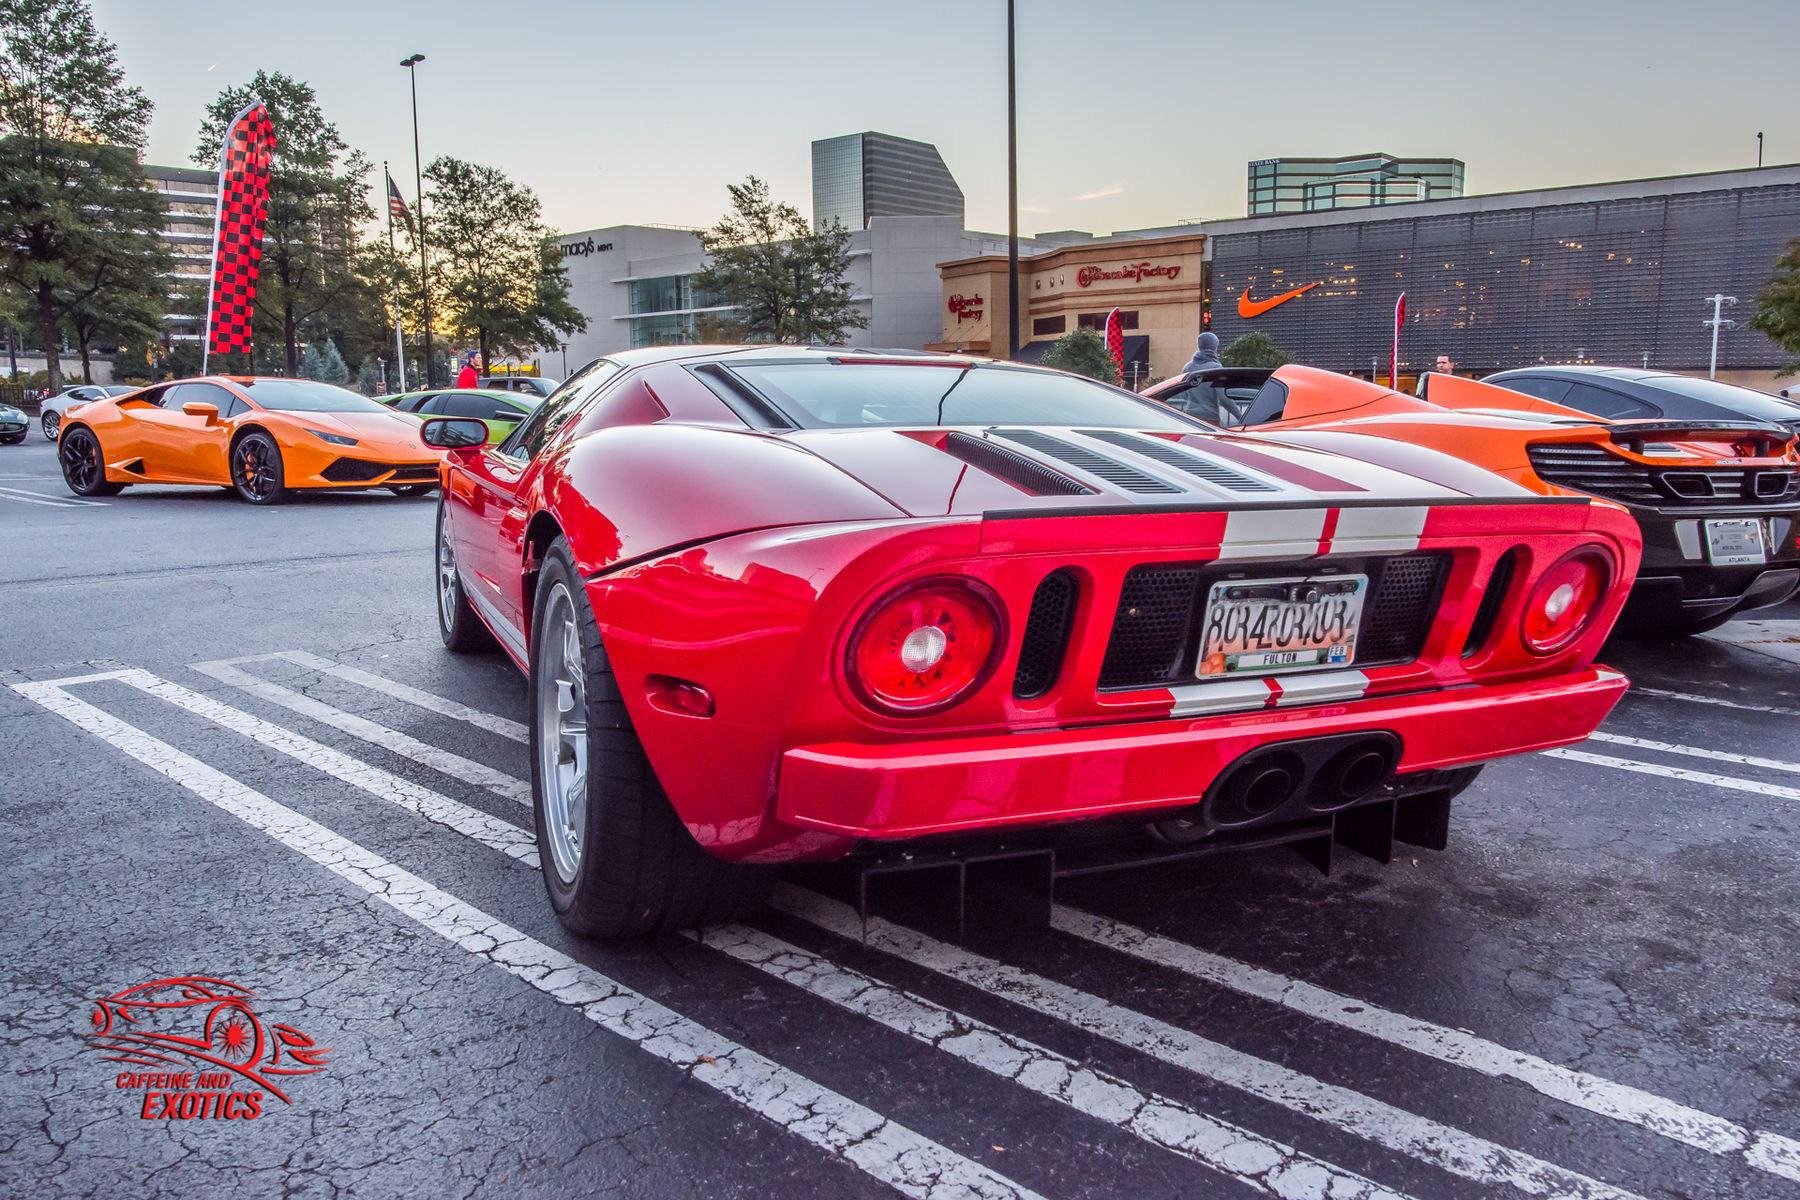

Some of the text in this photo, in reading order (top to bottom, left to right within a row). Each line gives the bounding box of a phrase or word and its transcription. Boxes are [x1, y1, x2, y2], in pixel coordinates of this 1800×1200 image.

[561, 236, 595, 257] macy's
[1076, 262, 1181, 288] Cheesecake Factory
[1263, 652, 1298, 665] FULTON
[1329, 646, 1345, 656] FEB
